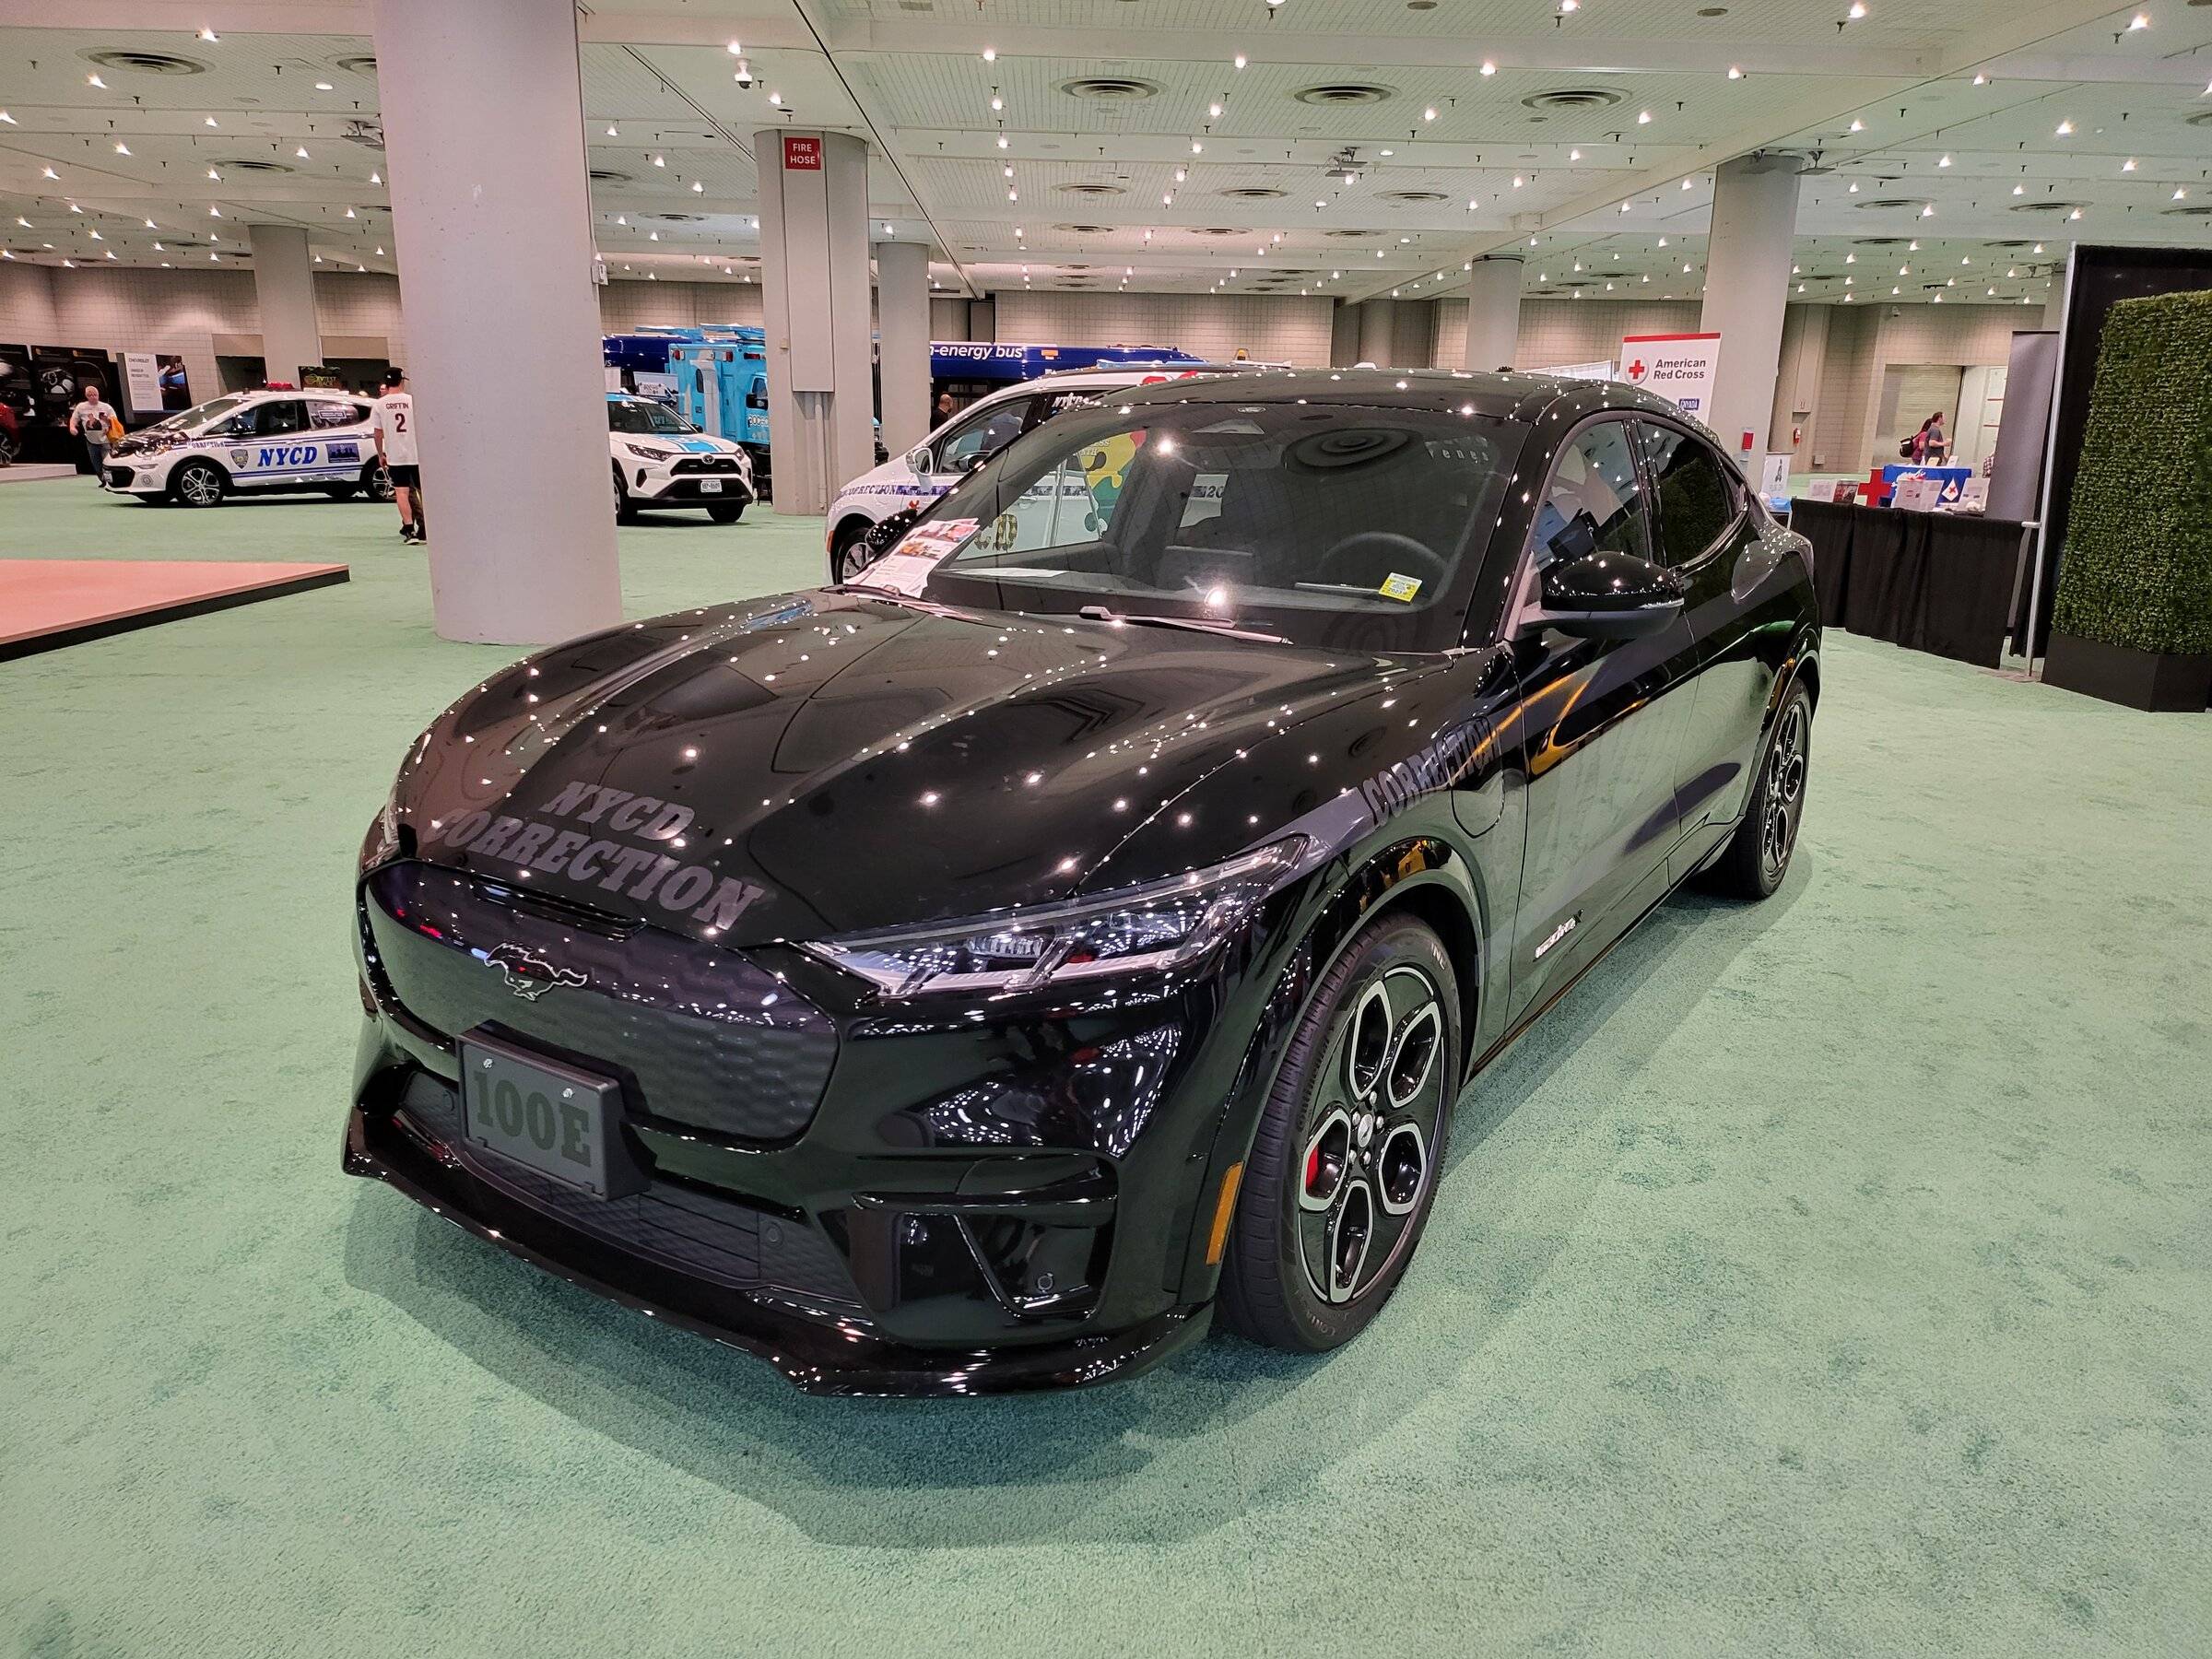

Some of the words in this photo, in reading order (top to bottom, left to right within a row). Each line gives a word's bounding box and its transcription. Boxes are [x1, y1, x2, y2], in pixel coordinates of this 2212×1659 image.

[793, 143, 812, 152] FIRE
[790, 155, 816, 165] HOSE
[995, 345, 1024, 359] bus
[1655, 359, 1707, 369] American
[1653, 370, 1674, 380] Red
[1675, 370, 1705, 380] Cross
[385, 402, 409, 410] GRIFFIN
[394, 413, 407, 433] 2
[257, 446, 318, 467] NYCD
[539, 781, 696, 842] NYCD
[421, 807, 765, 931] CORRECTION
[473, 1070, 592, 1169] 100E
